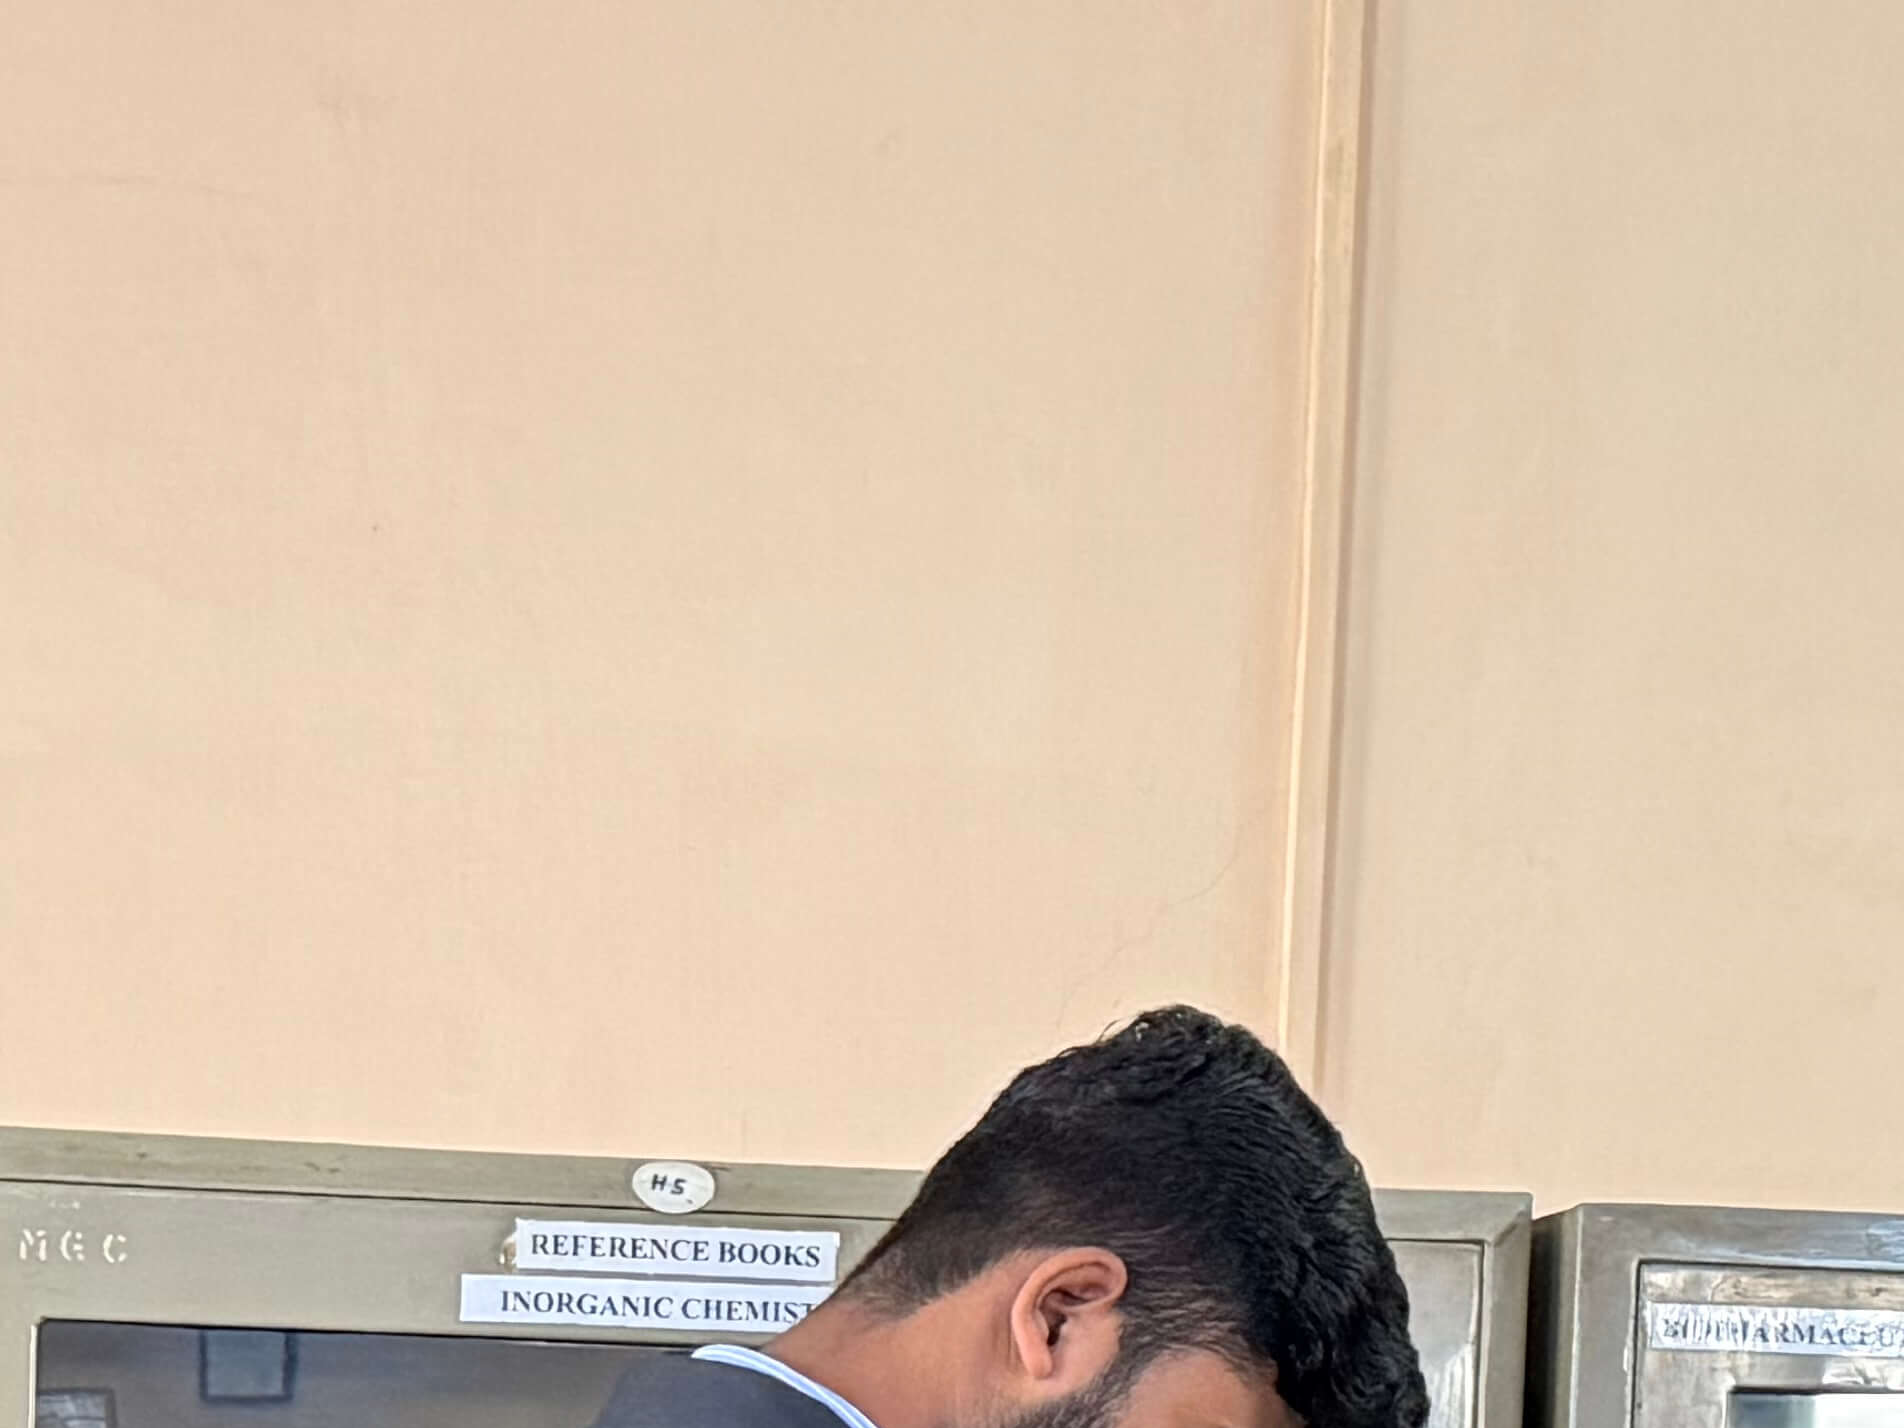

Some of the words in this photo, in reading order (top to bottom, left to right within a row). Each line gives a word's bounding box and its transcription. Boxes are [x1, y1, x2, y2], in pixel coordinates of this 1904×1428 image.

[530, 1234, 709, 1264] REFERENCE
[718, 1241, 821, 1267] BOOKS
[501, 1290, 674, 1318] INORGANIC
